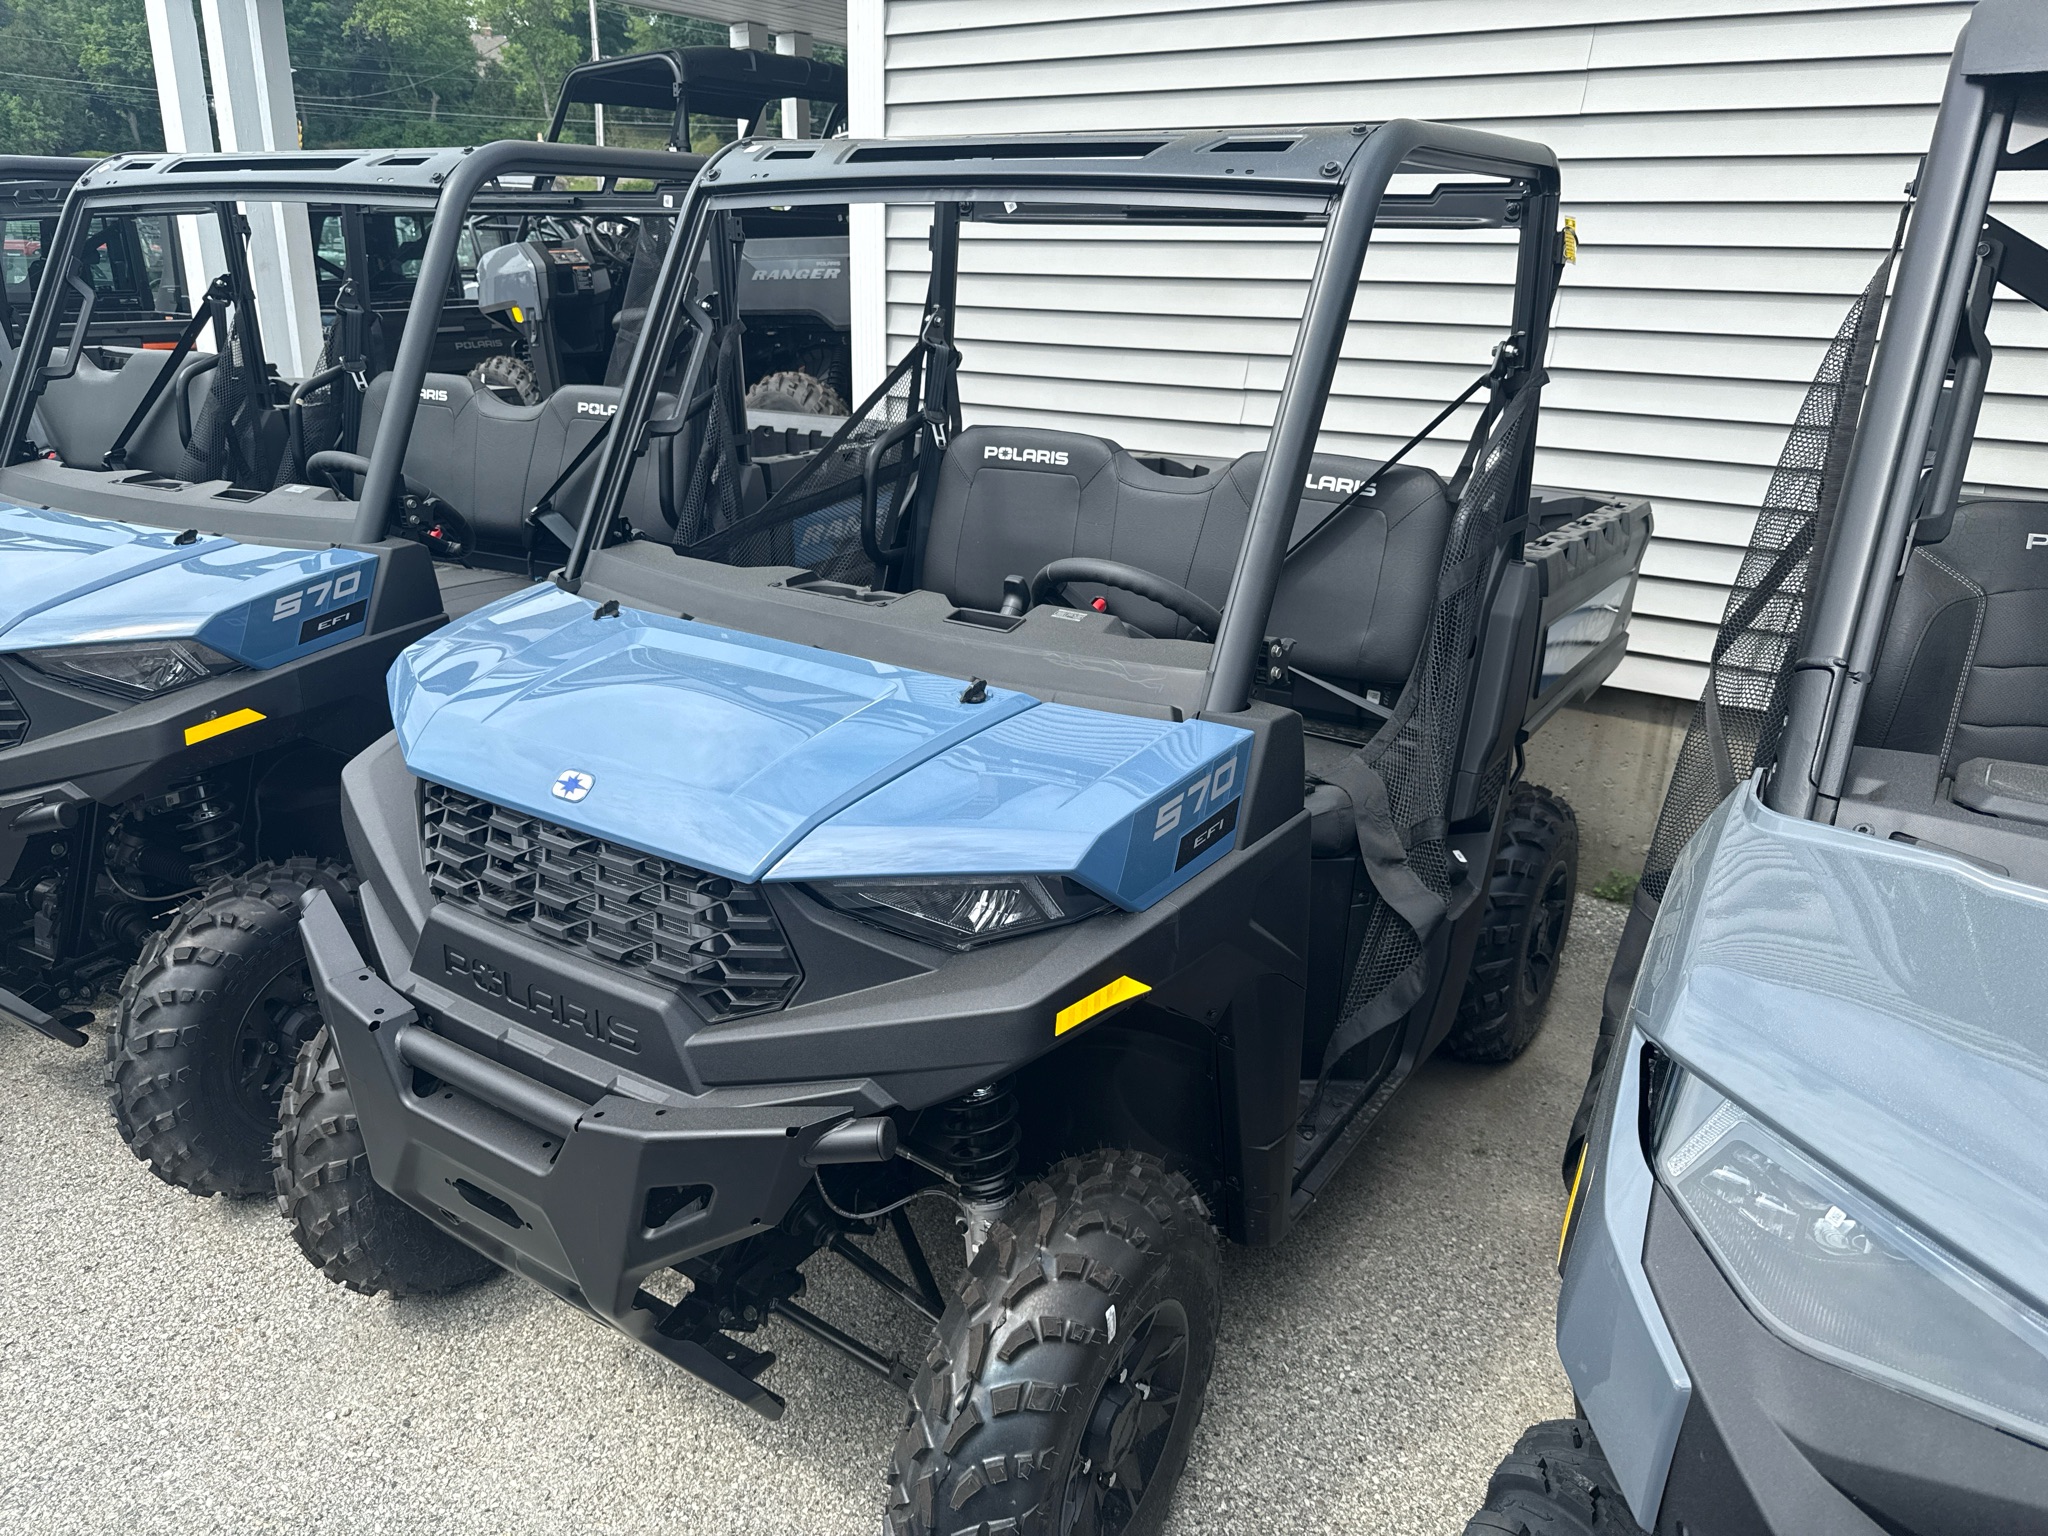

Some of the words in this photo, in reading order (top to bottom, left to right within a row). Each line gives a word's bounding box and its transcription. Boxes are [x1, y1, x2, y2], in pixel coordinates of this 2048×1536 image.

[752, 268, 841, 281] RANGER
[454, 339, 503, 350] POLARIS
[420, 388, 448, 402] ARIS
[577, 401, 618, 416] POLA
[983, 446, 1069, 466] POLARIS
[1305, 473, 1377, 497] LARIS
[2026, 532, 2048, 550] P
[272, 570, 362, 622] 570
[317, 612, 350, 631] EFI
[1152, 755, 1238, 842] 570
[1193, 818, 1225, 849] EFI
[443, 943, 643, 1056] POLARIS
